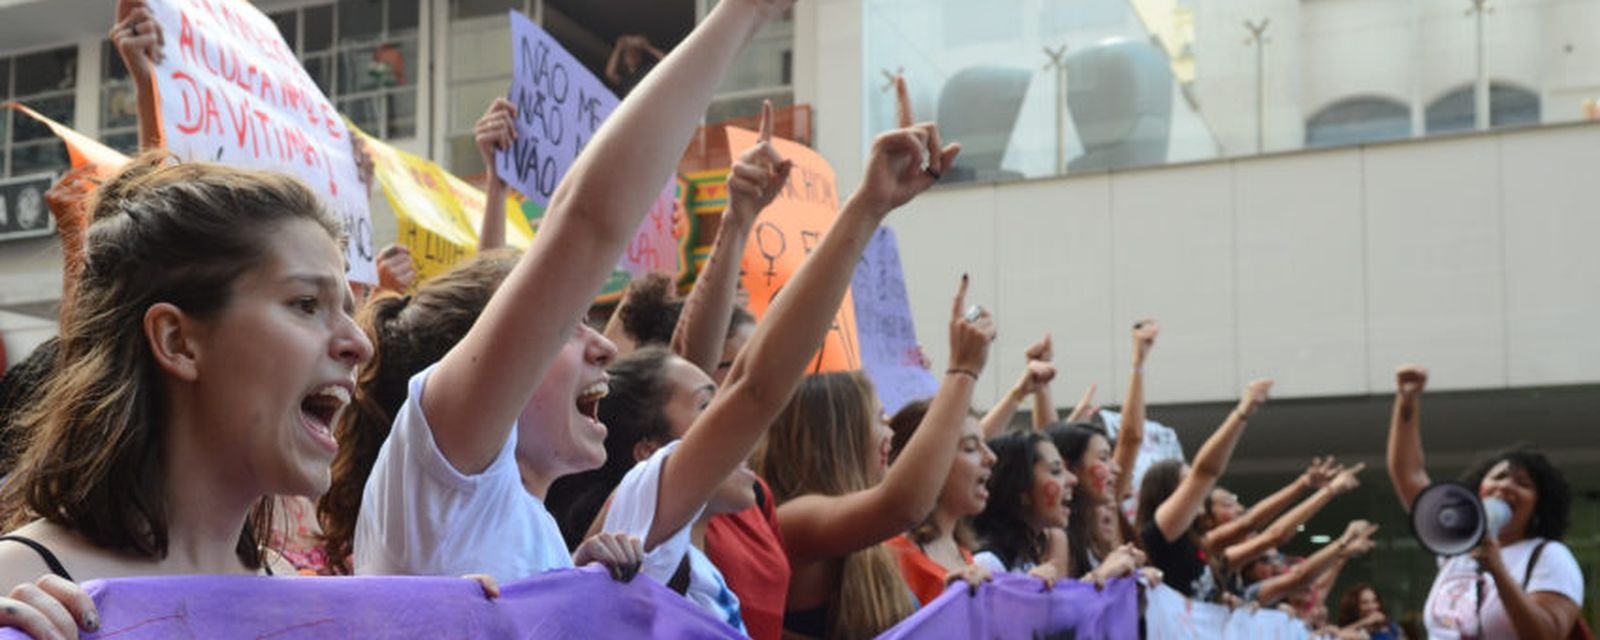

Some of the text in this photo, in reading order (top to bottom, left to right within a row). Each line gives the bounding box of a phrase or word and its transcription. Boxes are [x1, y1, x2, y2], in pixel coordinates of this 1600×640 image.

[521, 34, 569, 105] NÃO
[518, 86, 564, 147] NÃO
[504, 136, 557, 198] NÃO
